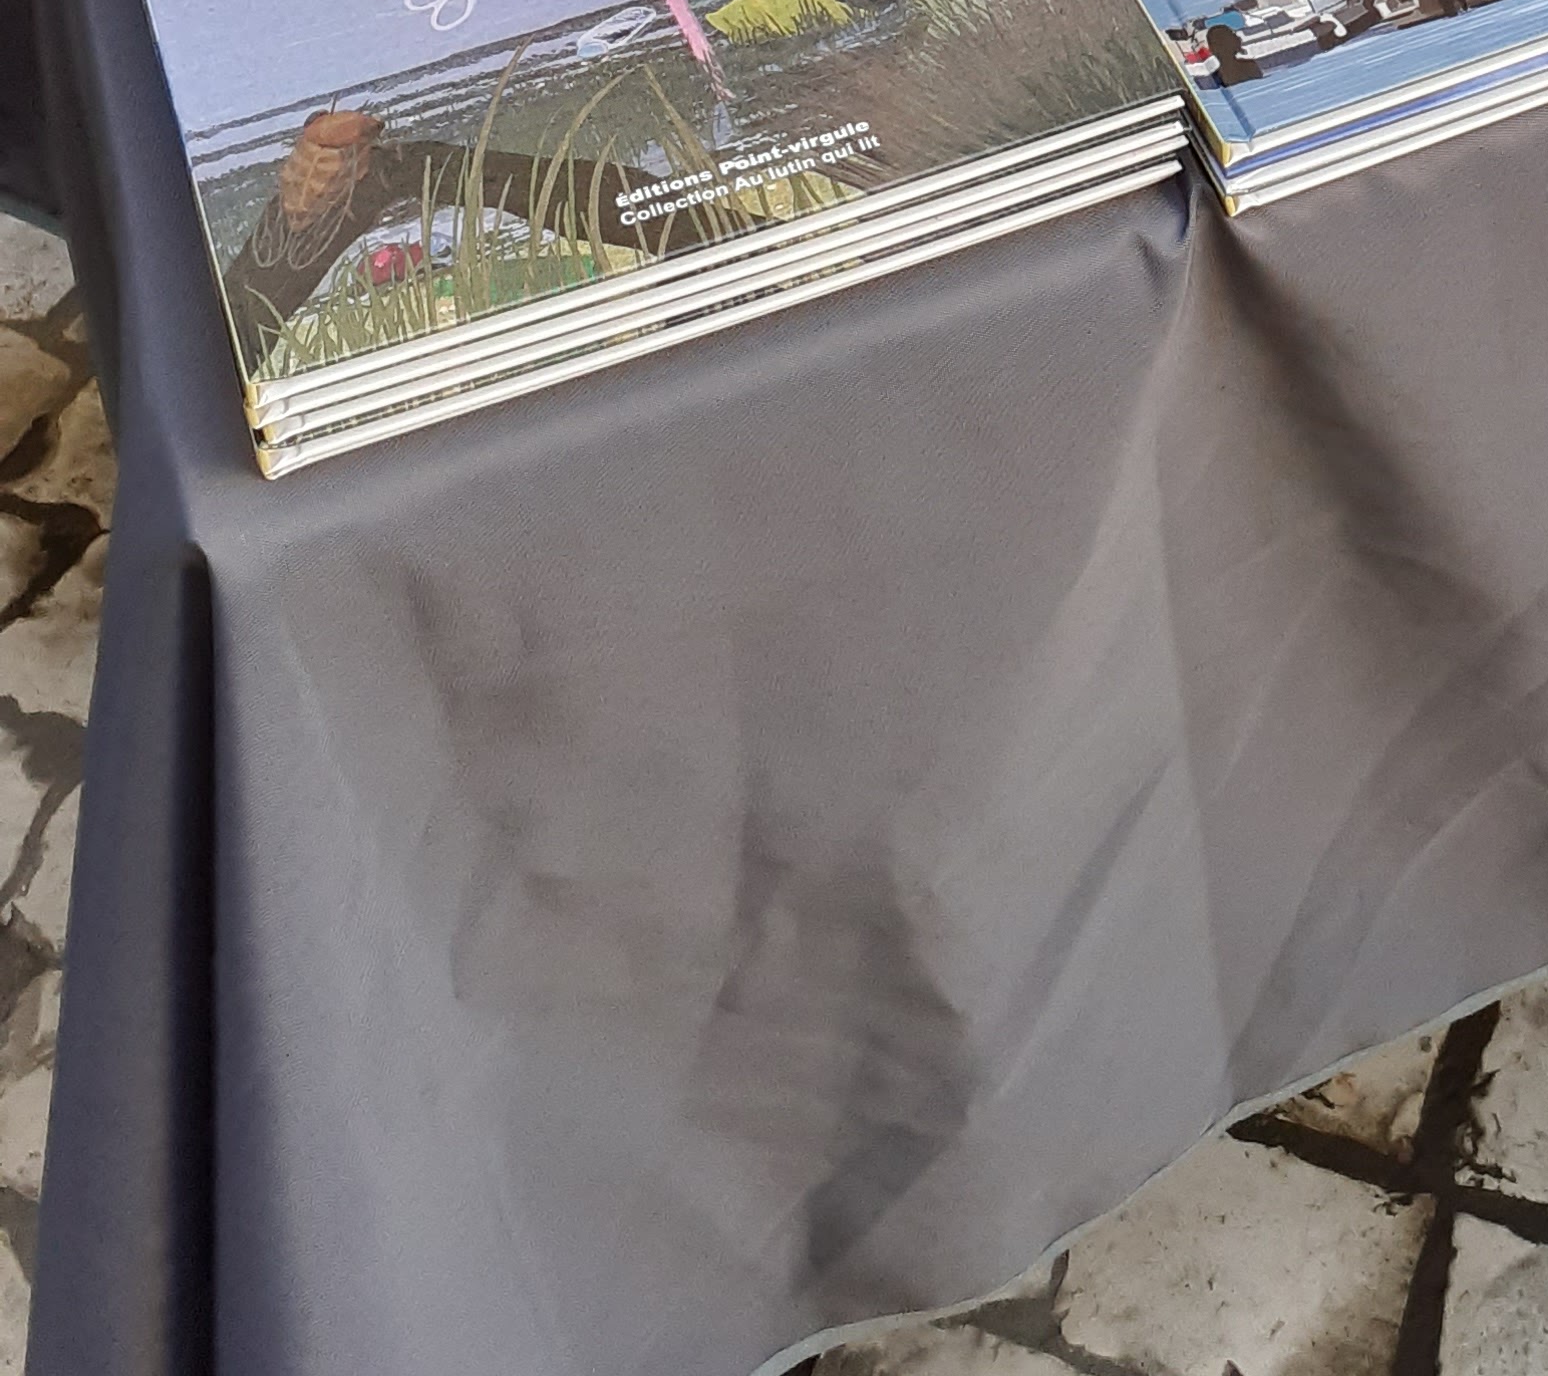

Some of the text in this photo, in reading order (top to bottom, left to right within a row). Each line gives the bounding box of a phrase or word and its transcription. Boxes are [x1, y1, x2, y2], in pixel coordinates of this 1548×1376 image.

[615, 118, 871, 210] Éditions Point-virgule
[619, 133, 881, 226] Collection Au lutin qui lit
